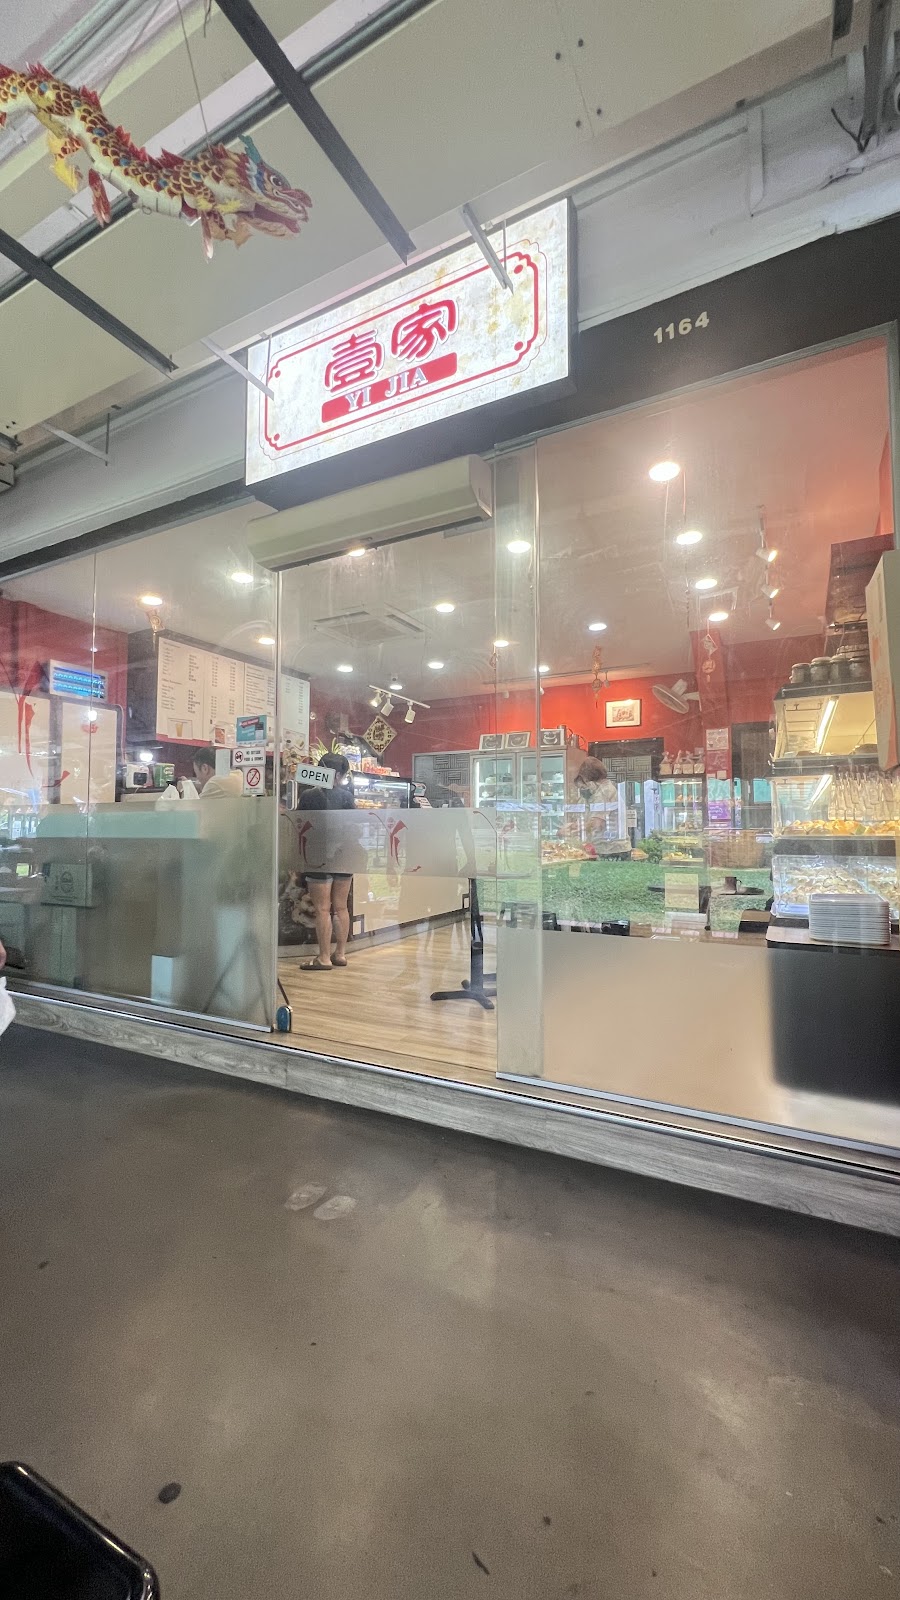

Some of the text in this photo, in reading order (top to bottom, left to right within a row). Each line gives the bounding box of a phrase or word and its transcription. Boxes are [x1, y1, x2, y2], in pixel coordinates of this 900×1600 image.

[324, 299, 457, 392] 壹家
[653, 311, 710, 344] 1164
[345, 368, 428, 412] YI JIA
[301, 769, 329, 783] OPEN
